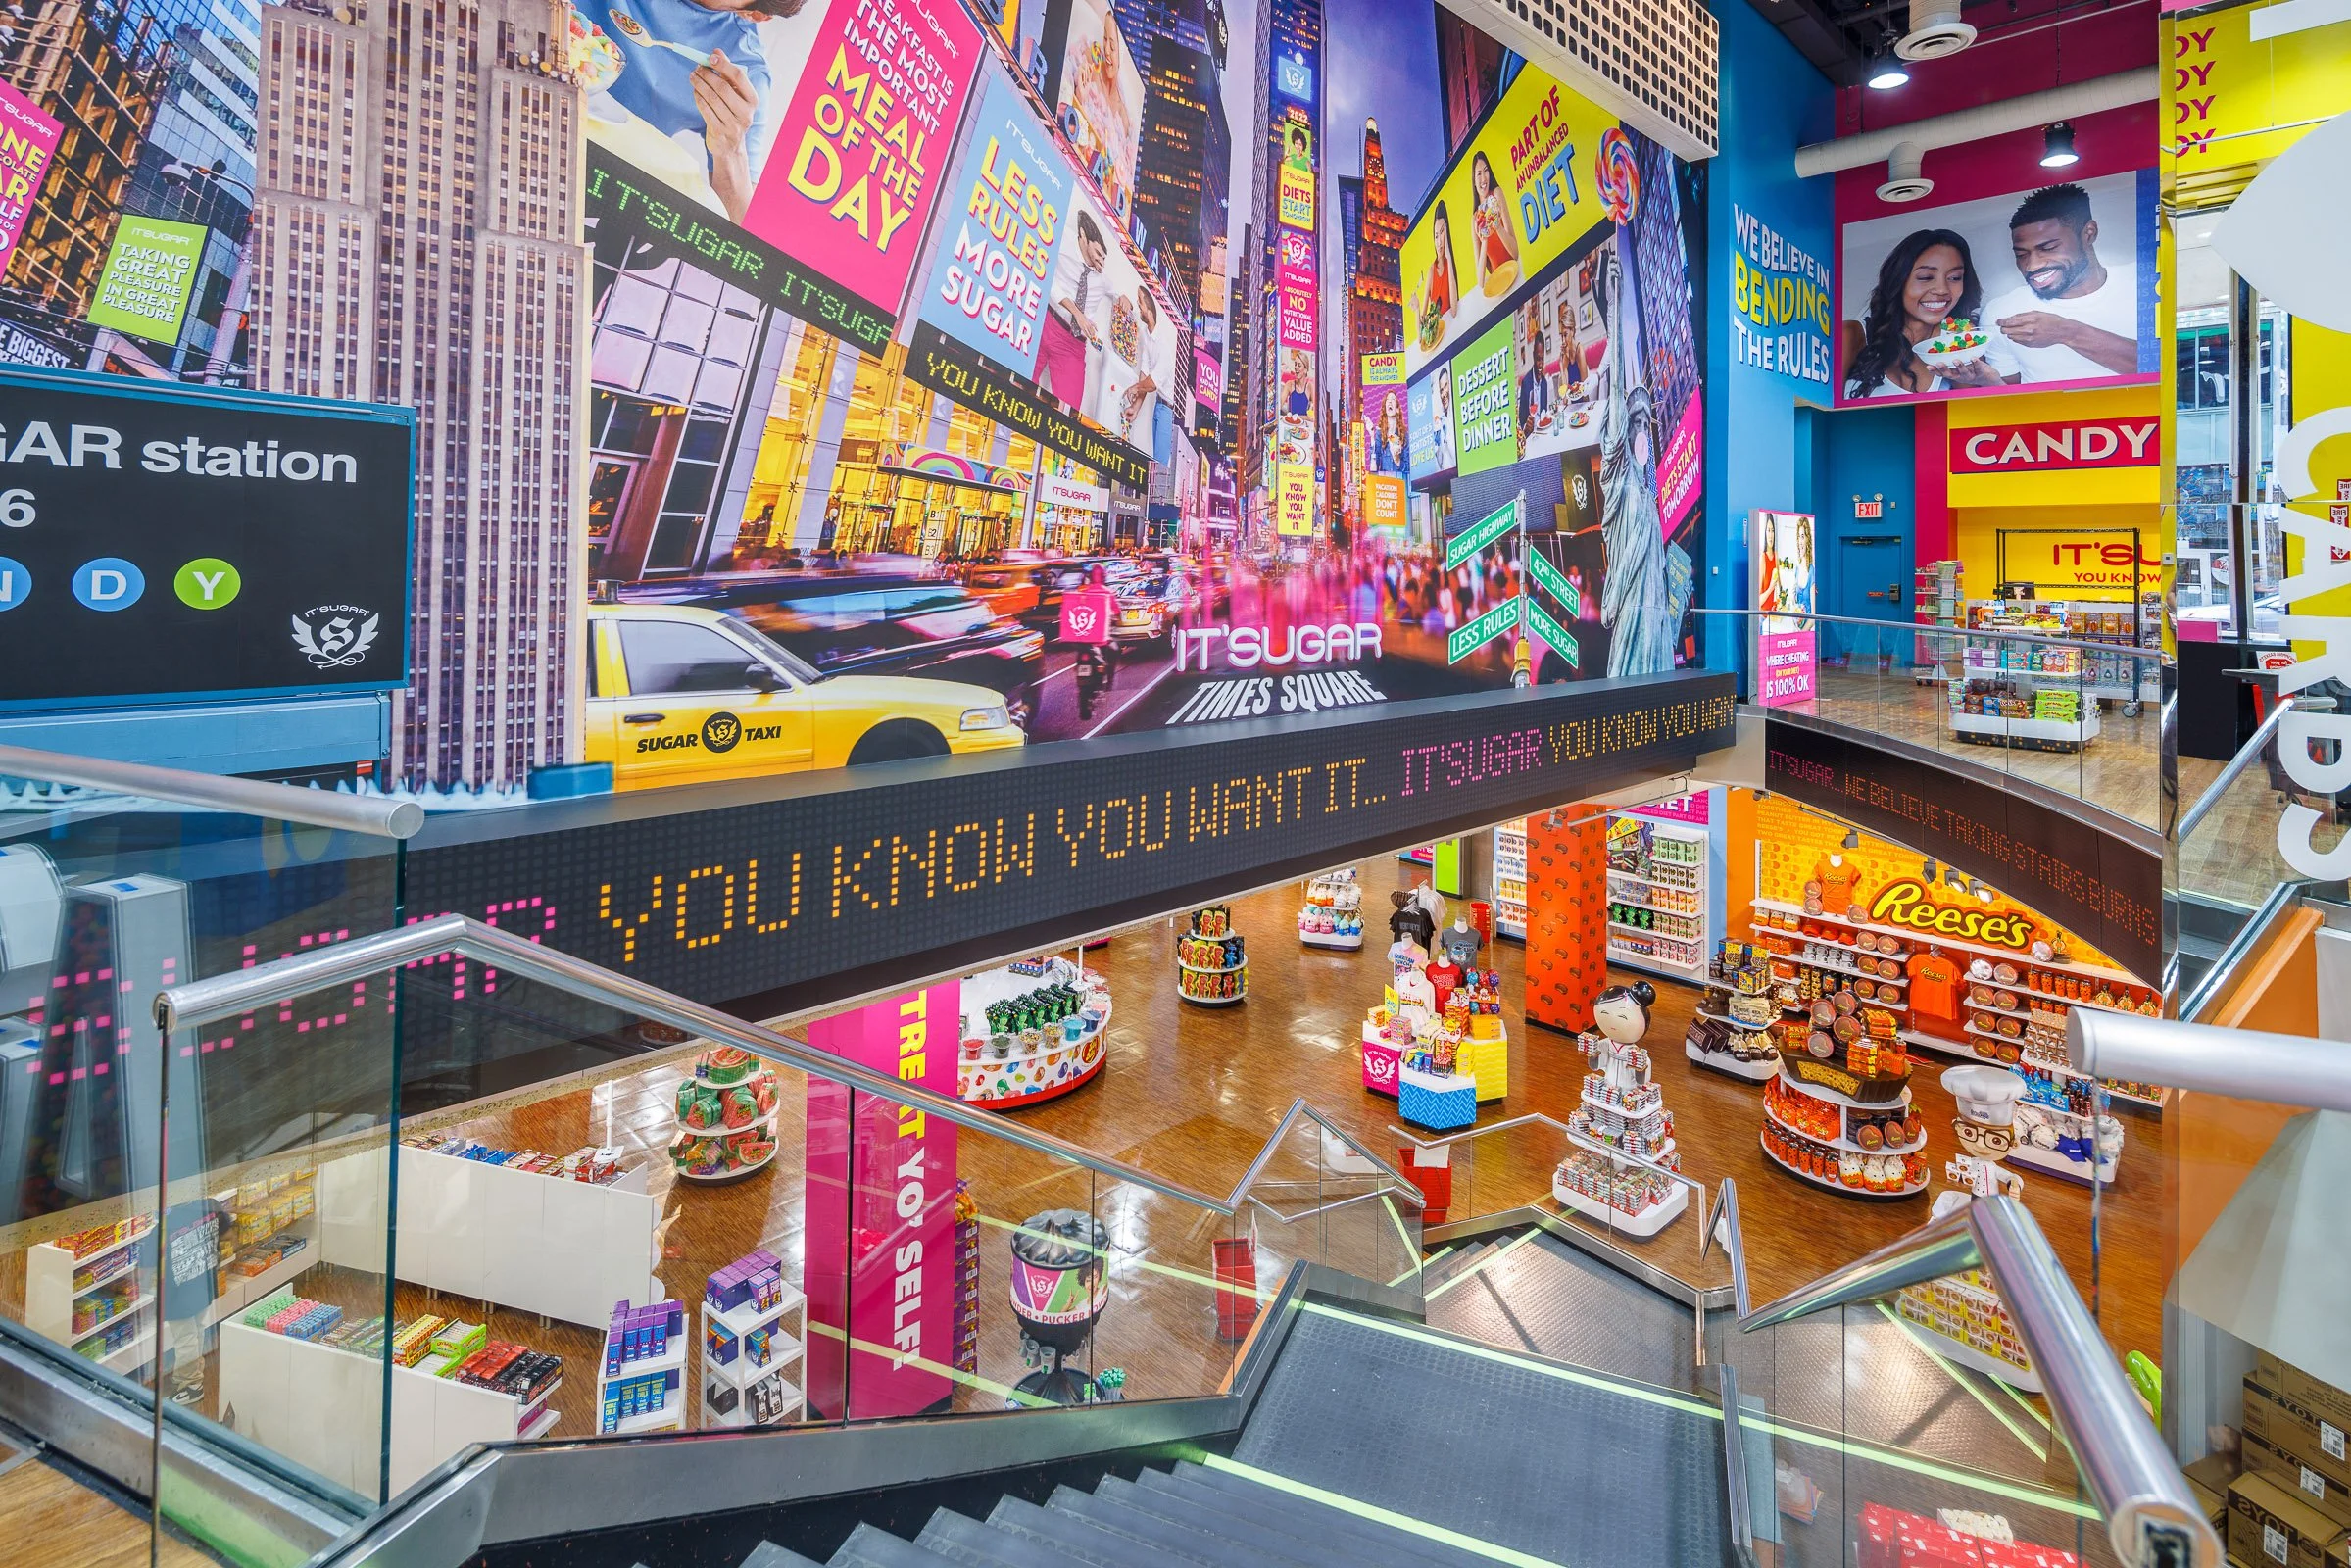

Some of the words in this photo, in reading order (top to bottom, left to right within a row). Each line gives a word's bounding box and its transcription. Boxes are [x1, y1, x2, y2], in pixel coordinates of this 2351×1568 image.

[855, 0, 894, 56] THE
[898, 50, 950, 117] MOST
[879, 0, 943, 76] EAKFAST
[940, 75, 955, 97] IS
[843, 17, 941, 135] IMPORTANT
[825, 42, 927, 178] MEAL
[1510, 115, 1539, 171] PART
[1541, 84, 1561, 128] OF
[814, 93, 865, 152] OF
[868, 136, 924, 210] THE
[1524, 122, 1569, 180] UNBALANCED
[787, 124, 912, 254] DAY
[980, 135, 1058, 246] LESS
[1282, 198, 1312, 216] START
[1283, 184, 1311, 204] DIETS
[1519, 142, 1580, 245] DIET
[587, 168, 765, 280] IT'SUGAR
[968, 180, 1050, 281] RULES
[1734, 202, 1759, 263] WE
[1761, 223, 1815, 279] BELIEVE
[1816, 262, 1830, 294] IN
[114, 257, 188, 284] GREAT
[120, 243, 191, 269] TAKING
[953, 219, 1042, 320] MORE
[102, 294, 175, 323] PLEASURE
[105, 283, 123, 297] IN
[125, 288, 180, 312] GREAT
[110, 270, 182, 297] PLEASURE
[1289, 294, 1306, 312] NO
[1735, 250, 1830, 337] BENDING
[940, 264, 1034, 357] SUGAR
[1283, 328, 1312, 344] ADDED
[1284, 316, 1312, 333] VALUE
[7, 330, 71, 368] BIGGEST
[1200, 363, 1219, 387] YOU
[1369, 356, 1398, 368] CANDY
[1457, 345, 1510, 398] DESSERT
[1734, 315, 1774, 370] THE
[1778, 331, 1830, 385] RULES
[926, 352, 981, 397] YOU
[982, 381, 1043, 430] KNOW
[1047, 418, 1081, 452] YOU
[1085, 440, 1125, 474] WANT
[1128, 466, 1147, 485] IT
[1460, 379, 1511, 424] BEFORE
[0, 421, 122, 468] AR
[141, 436, 357, 483] station
[1462, 413, 1513, 453] DINNER
[1965, 423, 2158, 466] CANDY
[1289, 483, 1303, 492] YOU
[1661, 466, 1678, 505] DIETS
[1678, 431, 1696, 478] START
[1663, 453, 1700, 524] TOMORROW
[1285, 492, 1306, 502] KNOW
[1289, 502, 1303, 512] YOU
[1375, 509, 1397, 518] COUNT
[1858, 502, 1880, 517] EXIT
[1293, 521, 1299, 530] IT
[1450, 535, 1477, 563] SUGAR
[1478, 508, 1514, 543] HIGHWAY
[90, 570, 127, 601] D
[192, 572, 226, 601] Y
[1550, 573, 1578, 610] STREET
[2074, 572, 2107, 584] YOU
[1176, 622, 1383, 673] IT'SUGAR
[1452, 628, 1479, 658] LESS
[1483, 603, 1517, 638] RULES
[1530, 608, 1551, 639] MORE
[1553, 631, 1578, 662] SUGAR
[1165, 677, 1273, 725] TIMES
[1280, 670, 1389, 712] SQUARE
[1766, 681, 1774, 699] IS
[1774, 677, 1796, 697] 100%
[1797, 674, 1809, 692] OK
[636, 733, 699, 754] SUGAR
[745, 726, 782, 742] TAXI
[1401, 728, 1542, 797] IT'SUGAR
[1549, 718, 1597, 764] YOU
[1602, 708, 1657, 754] KNOW
[1662, 702, 1697, 740] YOU
[599, 853, 802, 963] YOU
[831, 812, 1035, 919] KNOW
[1057, 790, 1171, 868] YOU
[1189, 765, 1312, 844] WANT
[1868, 781, 1940, 832] BELIEVE
[1944, 808, 2009, 864] TAKING
[2014, 843, 2085, 906] STAIRS
[2088, 877, 2157, 947] BURNS
[1872, 882, 2035, 949] Reese's
[896, 989, 928, 1140] TRET
[1042, 1312, 1085, 1325] PUCKER
